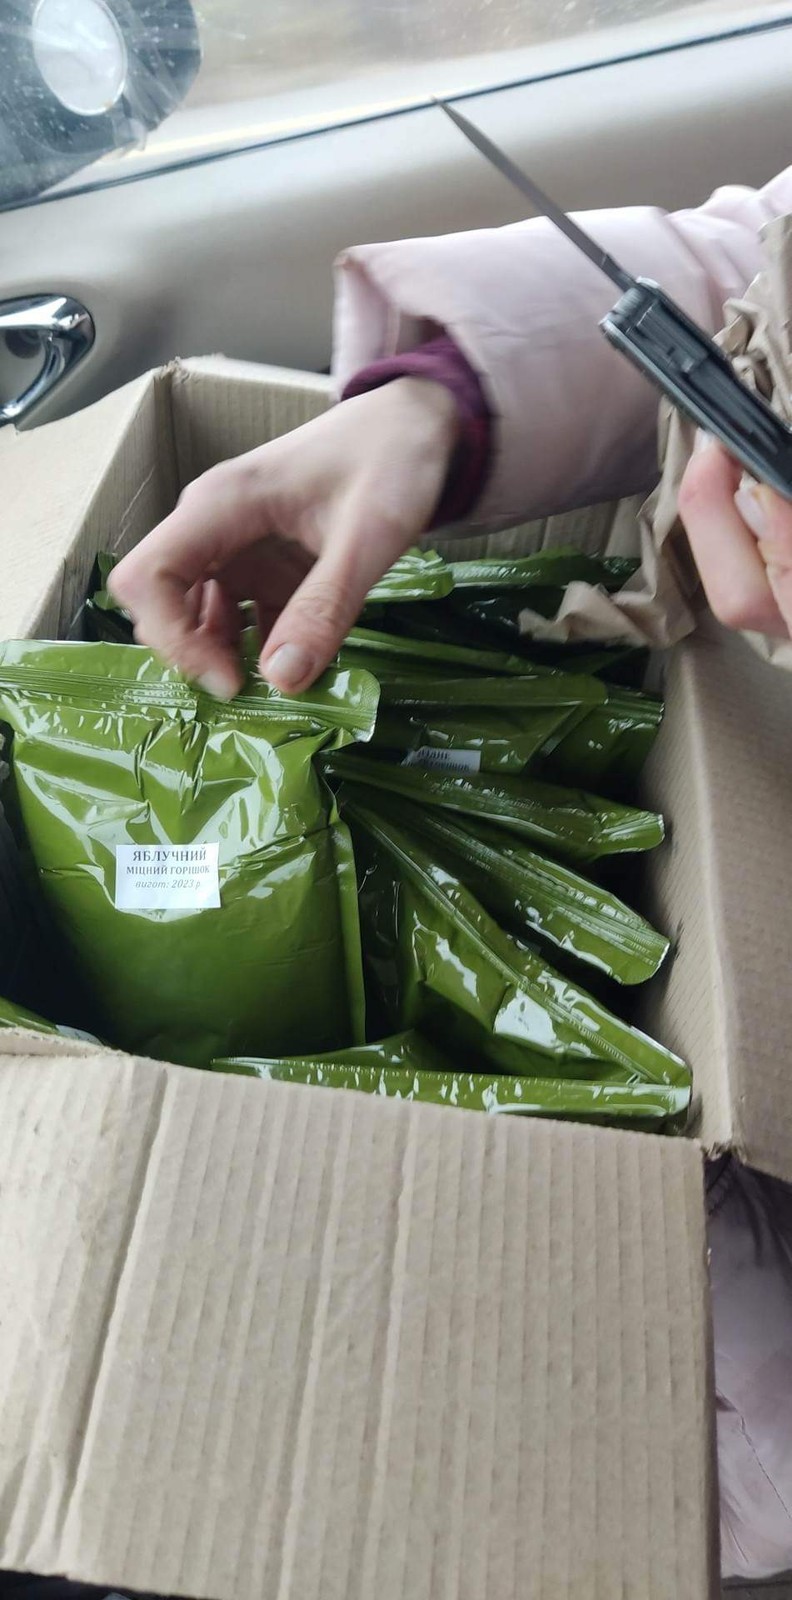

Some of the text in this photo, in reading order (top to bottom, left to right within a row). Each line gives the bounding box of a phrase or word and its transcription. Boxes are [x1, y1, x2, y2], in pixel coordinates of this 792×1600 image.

[133, 846, 206, 861] ЯБЛУЧНИЙ
[126, 864, 210, 875] МІЦНИЙ ГОРІШОК
[171, 879, 194, 888] 2023
